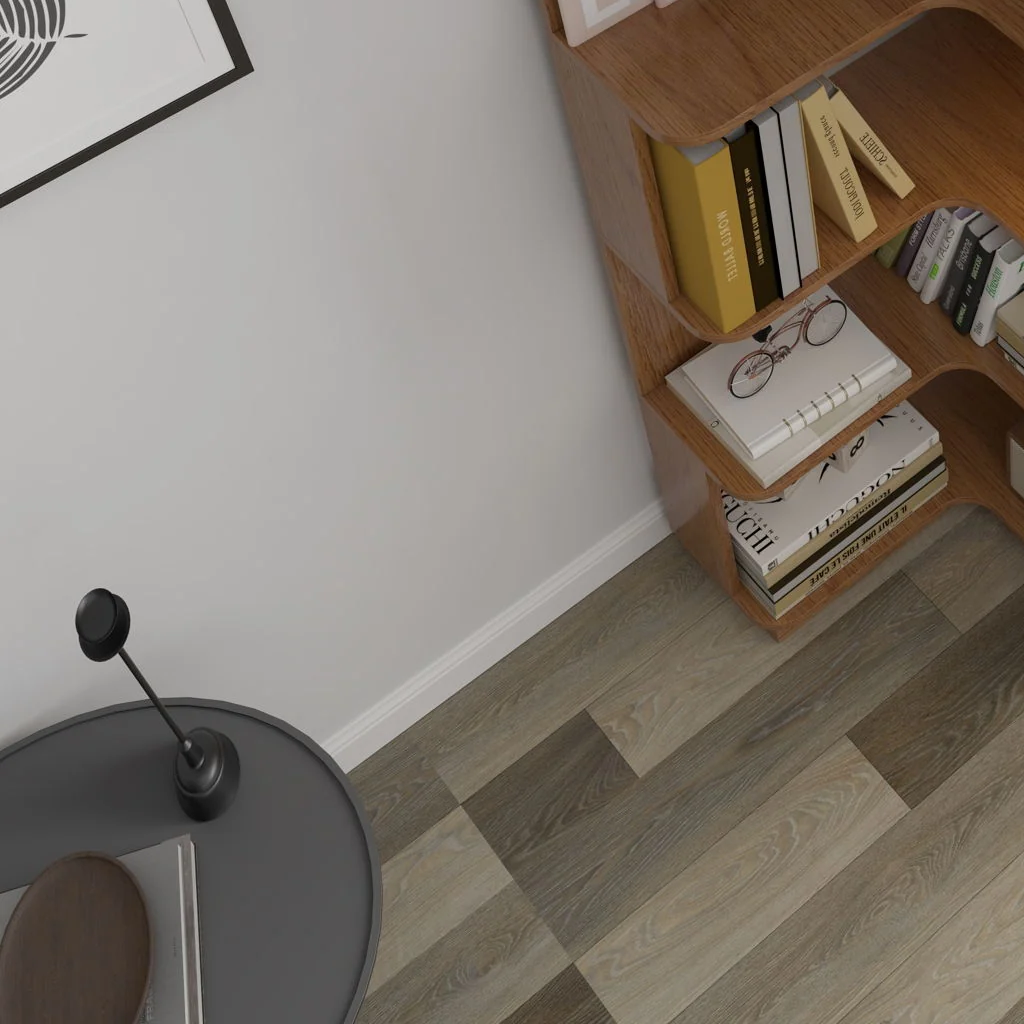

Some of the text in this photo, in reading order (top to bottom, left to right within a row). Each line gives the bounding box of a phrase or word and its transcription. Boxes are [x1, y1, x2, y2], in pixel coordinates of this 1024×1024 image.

[808, 460, 906, 541] NOGUCHI
[862, 530, 877, 545] UNE
[842, 542, 860, 560] FOIS
[832, 559, 841, 569] LE
